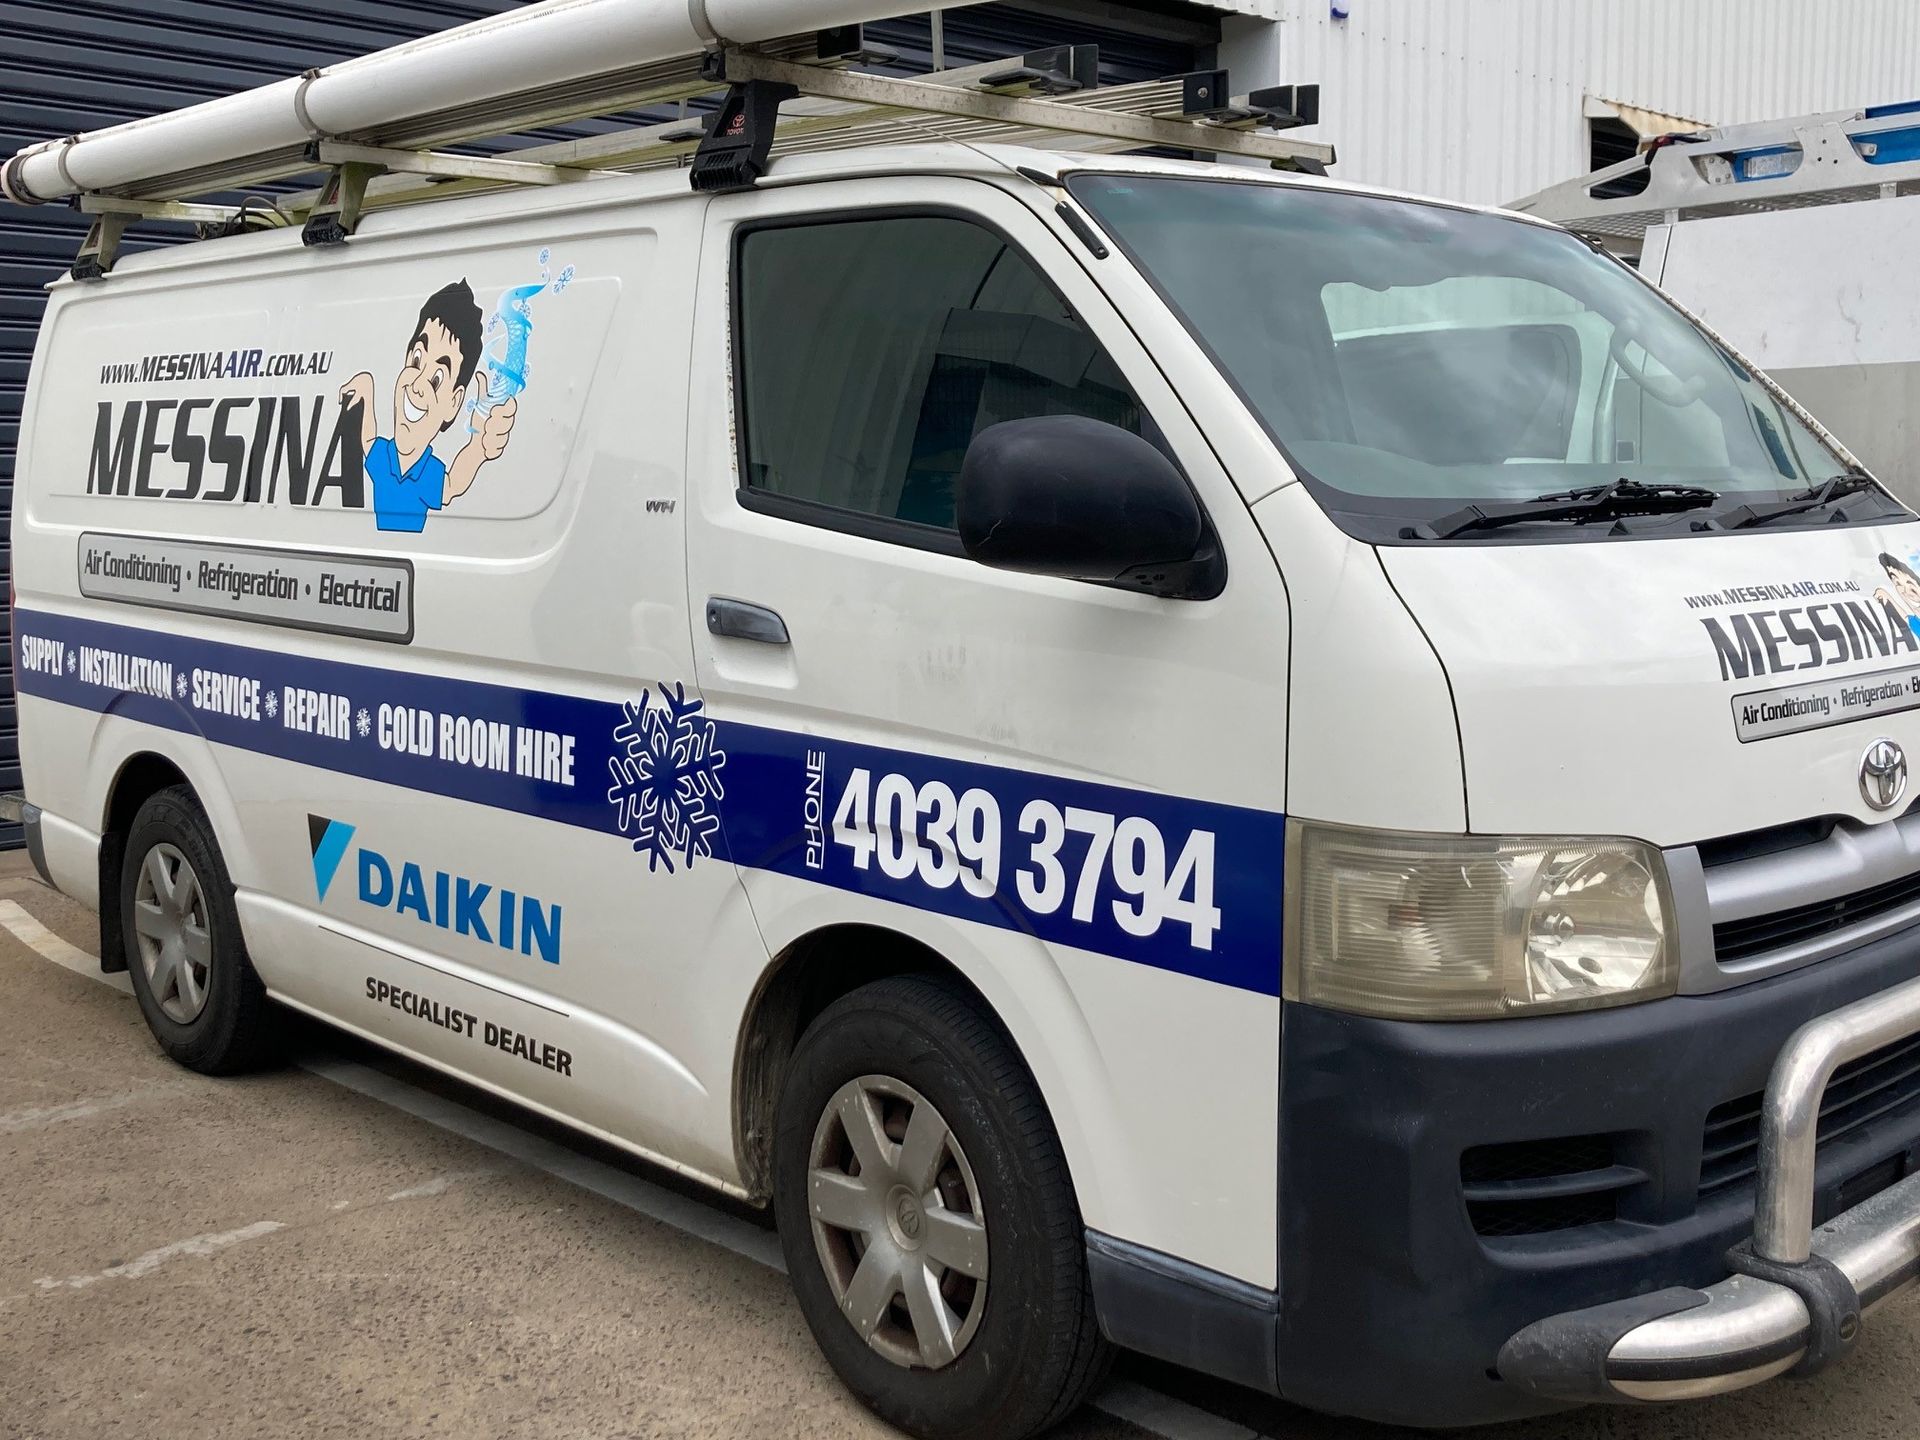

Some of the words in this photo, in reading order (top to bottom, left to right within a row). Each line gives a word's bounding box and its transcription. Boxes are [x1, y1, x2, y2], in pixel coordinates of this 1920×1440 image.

[86, 393, 365, 508] MESSINA
[84, 549, 102, 576] Air
[103, 551, 181, 592] Conditioning
[198, 561, 298, 600] Refrigeration
[318, 574, 400, 612] Electrical
[1699, 600, 1919, 681] MESSINA
[21, 634, 64, 676] SUPPLY
[79, 646, 173, 698] INSTALLATION
[192, 669, 261, 720] SERVICE
[283, 687, 351, 740] REPAIR
[377, 704, 434, 756] COLD
[439, 715, 510, 771] ROOM
[516, 728, 575, 786] HIRE
[1742, 706, 1760, 725] Air
[1761, 695, 1830, 721] Conditioning
[1841, 681, 1903, 708] Refrigeration
[804, 749, 824, 869] PHONE
[833, 768, 1000, 898] 4039
[1017, 799, 1220, 950] 3794
[358, 848, 562, 965] DAIKIN
[366, 976, 477, 1037] SPECIALIST
[484, 1022, 572, 1076] DEALER
